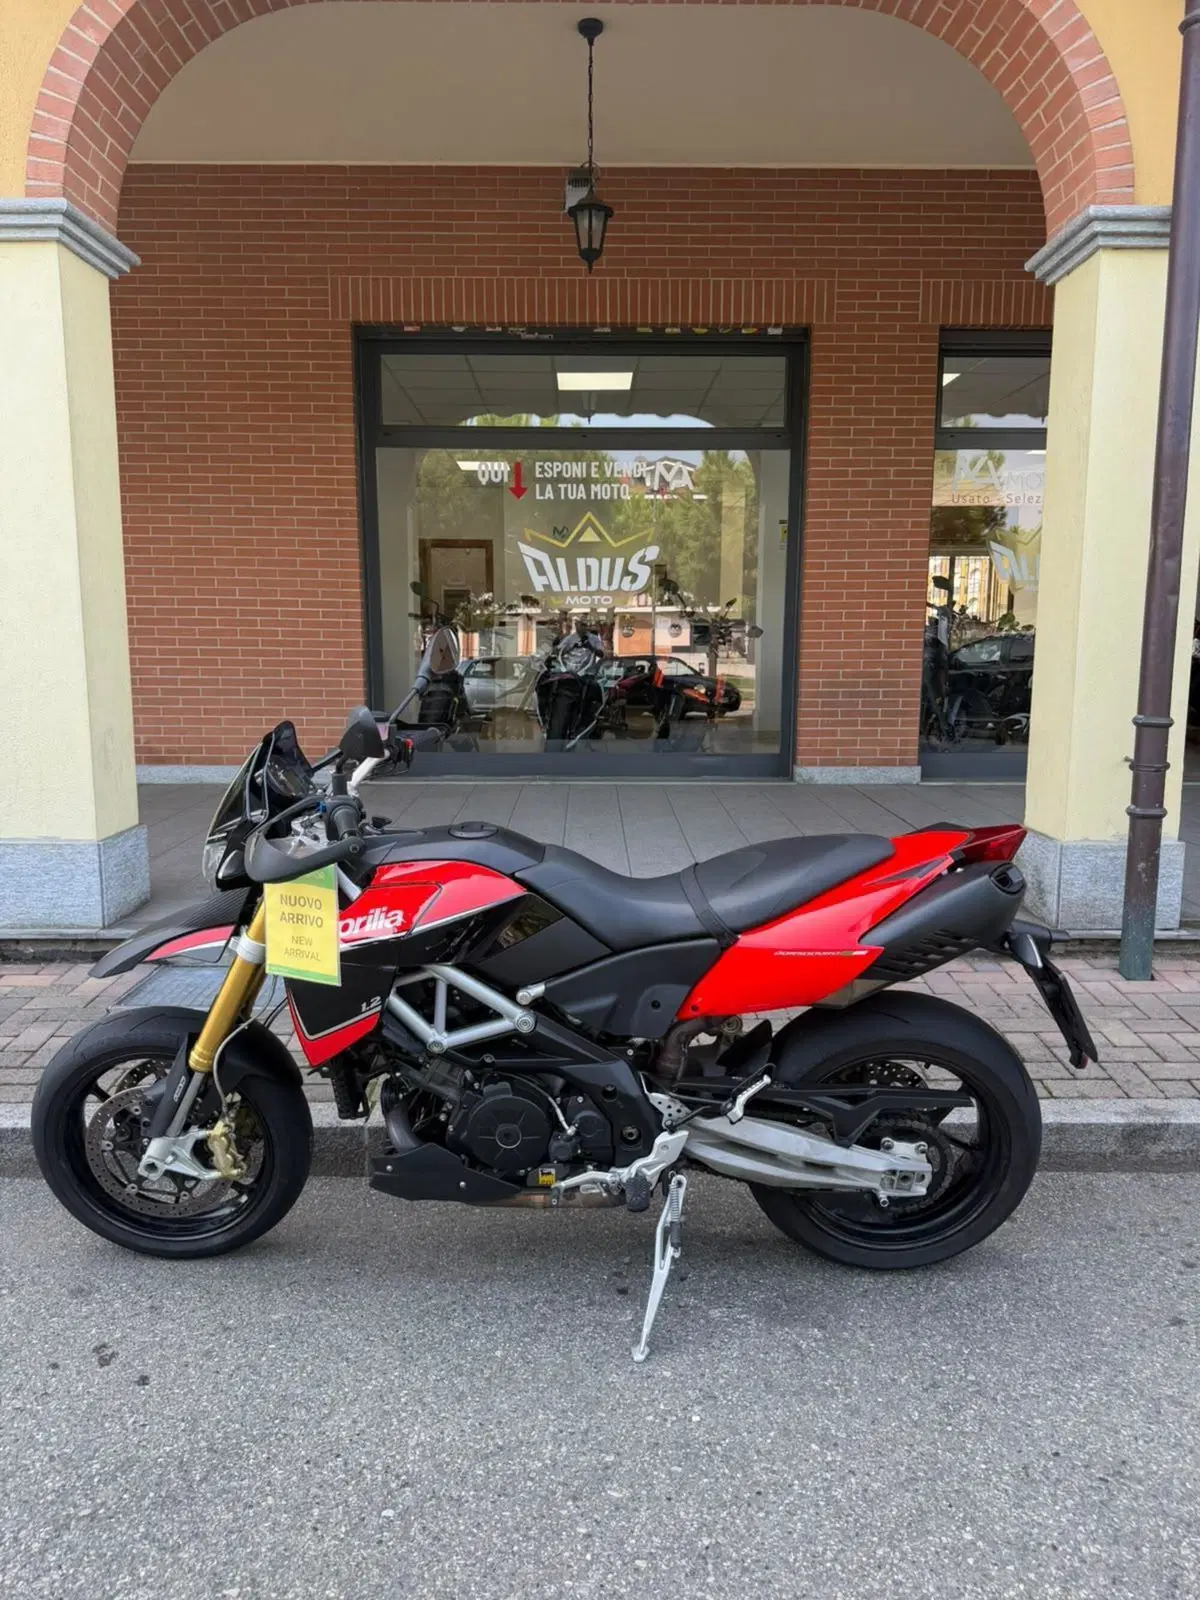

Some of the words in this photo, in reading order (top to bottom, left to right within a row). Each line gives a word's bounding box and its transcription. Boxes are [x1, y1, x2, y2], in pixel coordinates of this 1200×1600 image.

[477, 461, 509, 485] QUI
[535, 461, 586, 478] ESPONI
[591, 461, 599, 478] E
[535, 483, 554, 500] LA
[558, 483, 586, 500] TUA
[590, 483, 630, 500] MOTO
[951, 493, 990, 504] Usato
[1006, 493, 1042, 504] Selez
[517, 541, 660, 592] ALDUS
[565, 595, 613, 605] MOTO
[280, 893, 323, 911] NUOVO
[279, 911, 324, 928] ARRIVO
[291, 935, 313, 947] NEW
[284, 947, 321, 962] ARRIVAL
